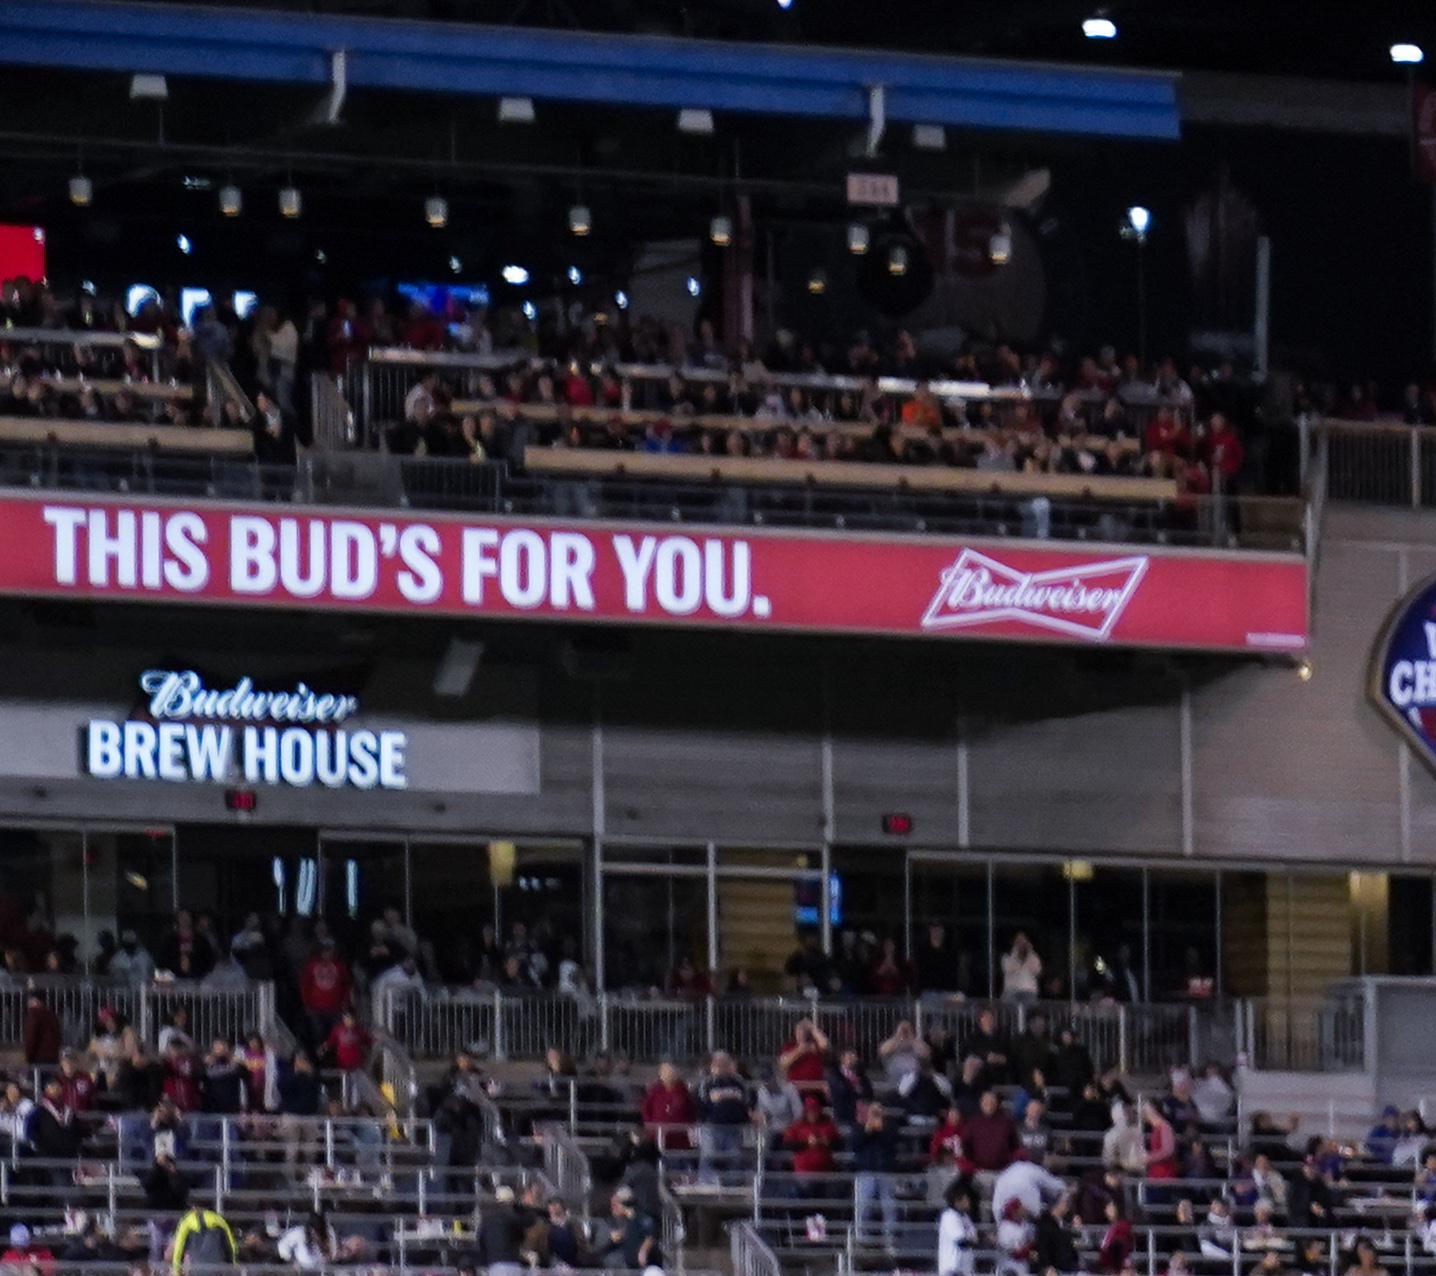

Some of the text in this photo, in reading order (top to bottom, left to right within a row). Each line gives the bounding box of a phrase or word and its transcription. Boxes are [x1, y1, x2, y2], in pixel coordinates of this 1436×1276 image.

[44, 506, 208, 592] THIS
[462, 528, 594, 611] FOR
[614, 534, 772, 618] YOU.
[940, 564, 1123, 612] Budweiser
[142, 669, 357, 722] Budweiser
[88, 720, 408, 789] BREW HOUSE
